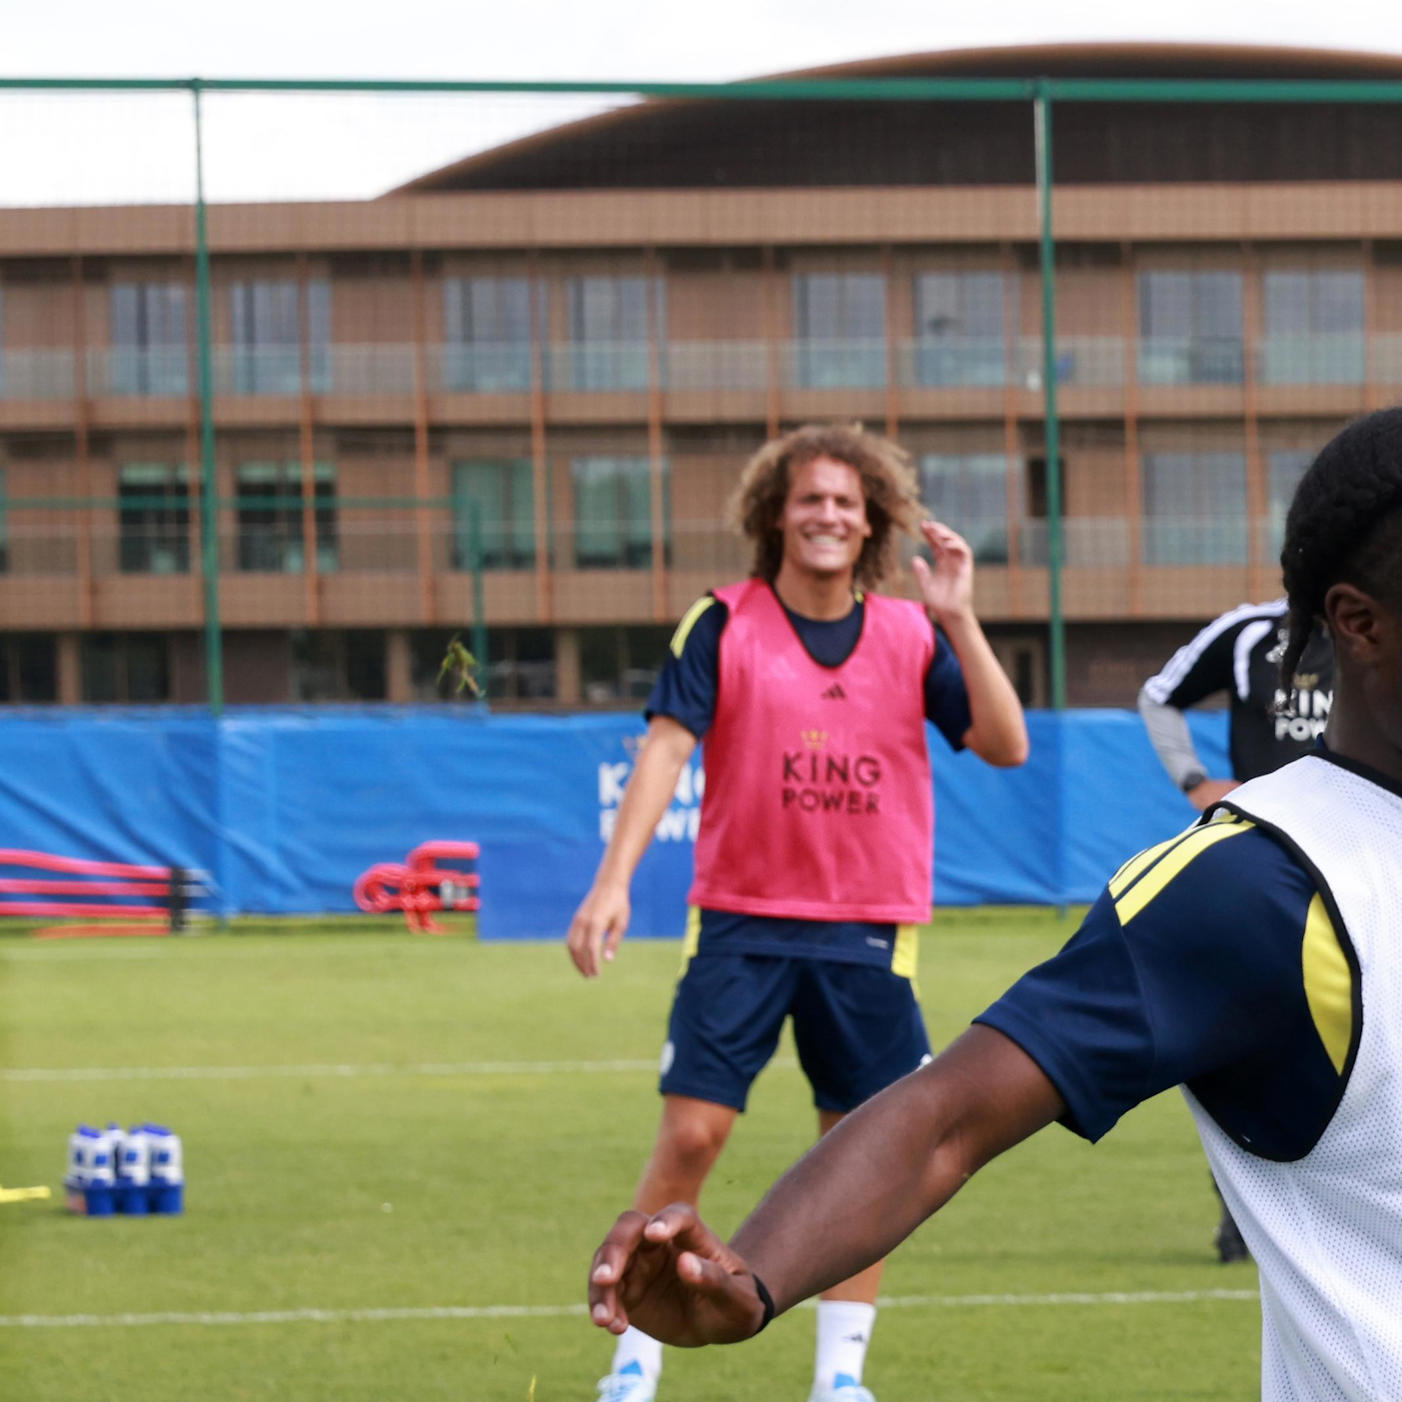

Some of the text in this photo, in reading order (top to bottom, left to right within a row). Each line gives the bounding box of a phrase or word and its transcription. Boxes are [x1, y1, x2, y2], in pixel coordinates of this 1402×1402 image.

[1274, 688, 1333, 718] KIN
[781, 752, 881, 786] KING
[781, 788, 881, 815] POWER
